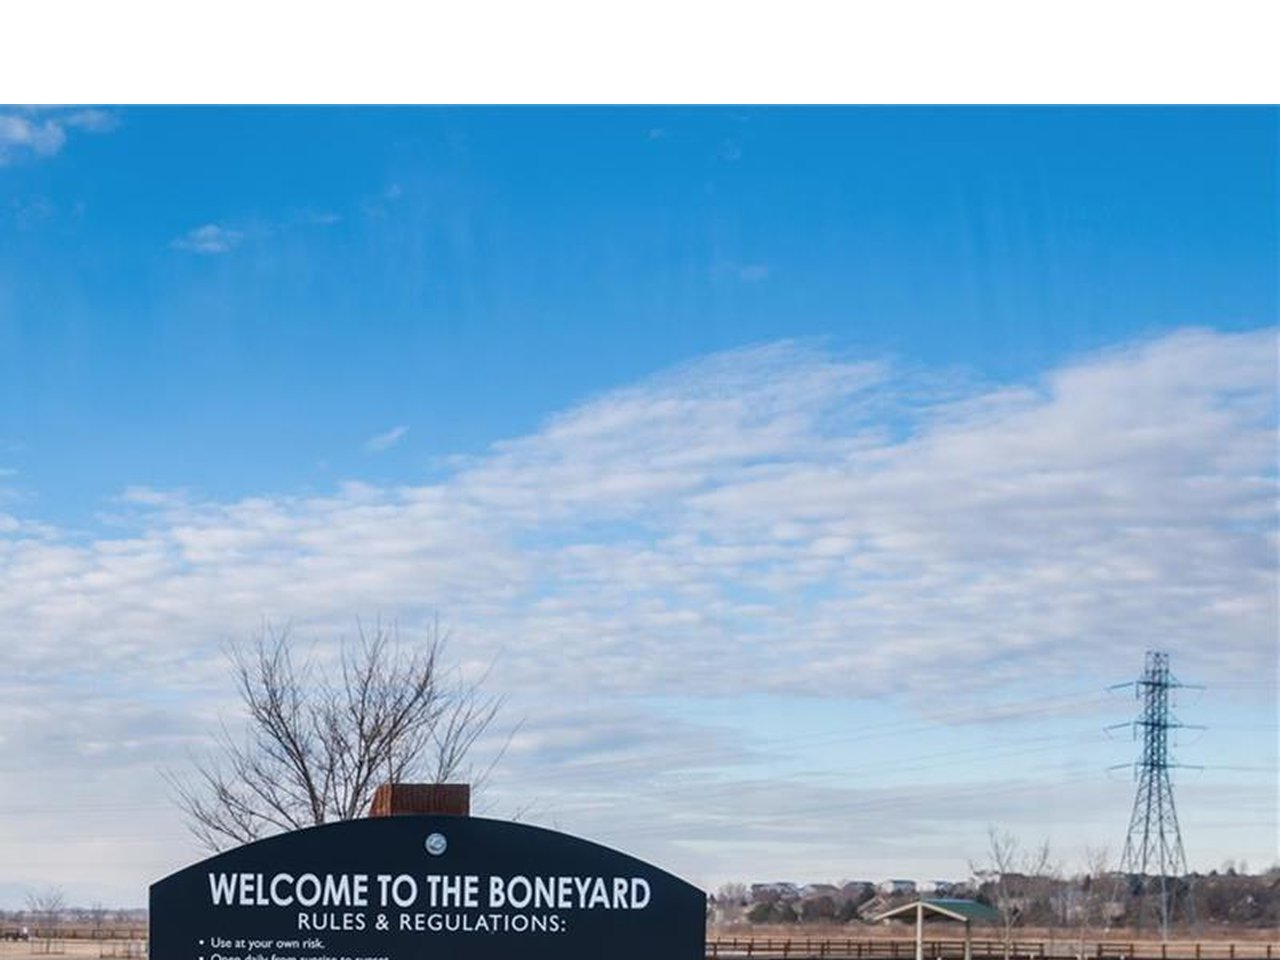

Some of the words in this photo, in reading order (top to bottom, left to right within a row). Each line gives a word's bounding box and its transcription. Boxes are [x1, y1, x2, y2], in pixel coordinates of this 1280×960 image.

[209, 872, 369, 907] WELCOME
[377, 874, 418, 908] TO
[427, 875, 479, 908] THE
[489, 875, 651, 909] BONEYARD
[298, 912, 366, 931] RULES
[375, 913, 389, 931] &
[400, 914, 566, 932] REGULATIONS:
[210, 937, 233, 949] Use
[234, 939, 247, 949] at
[247, 940, 274, 951] your
[275, 940, 300, 949] own
[302, 938, 326, 949] risk.
